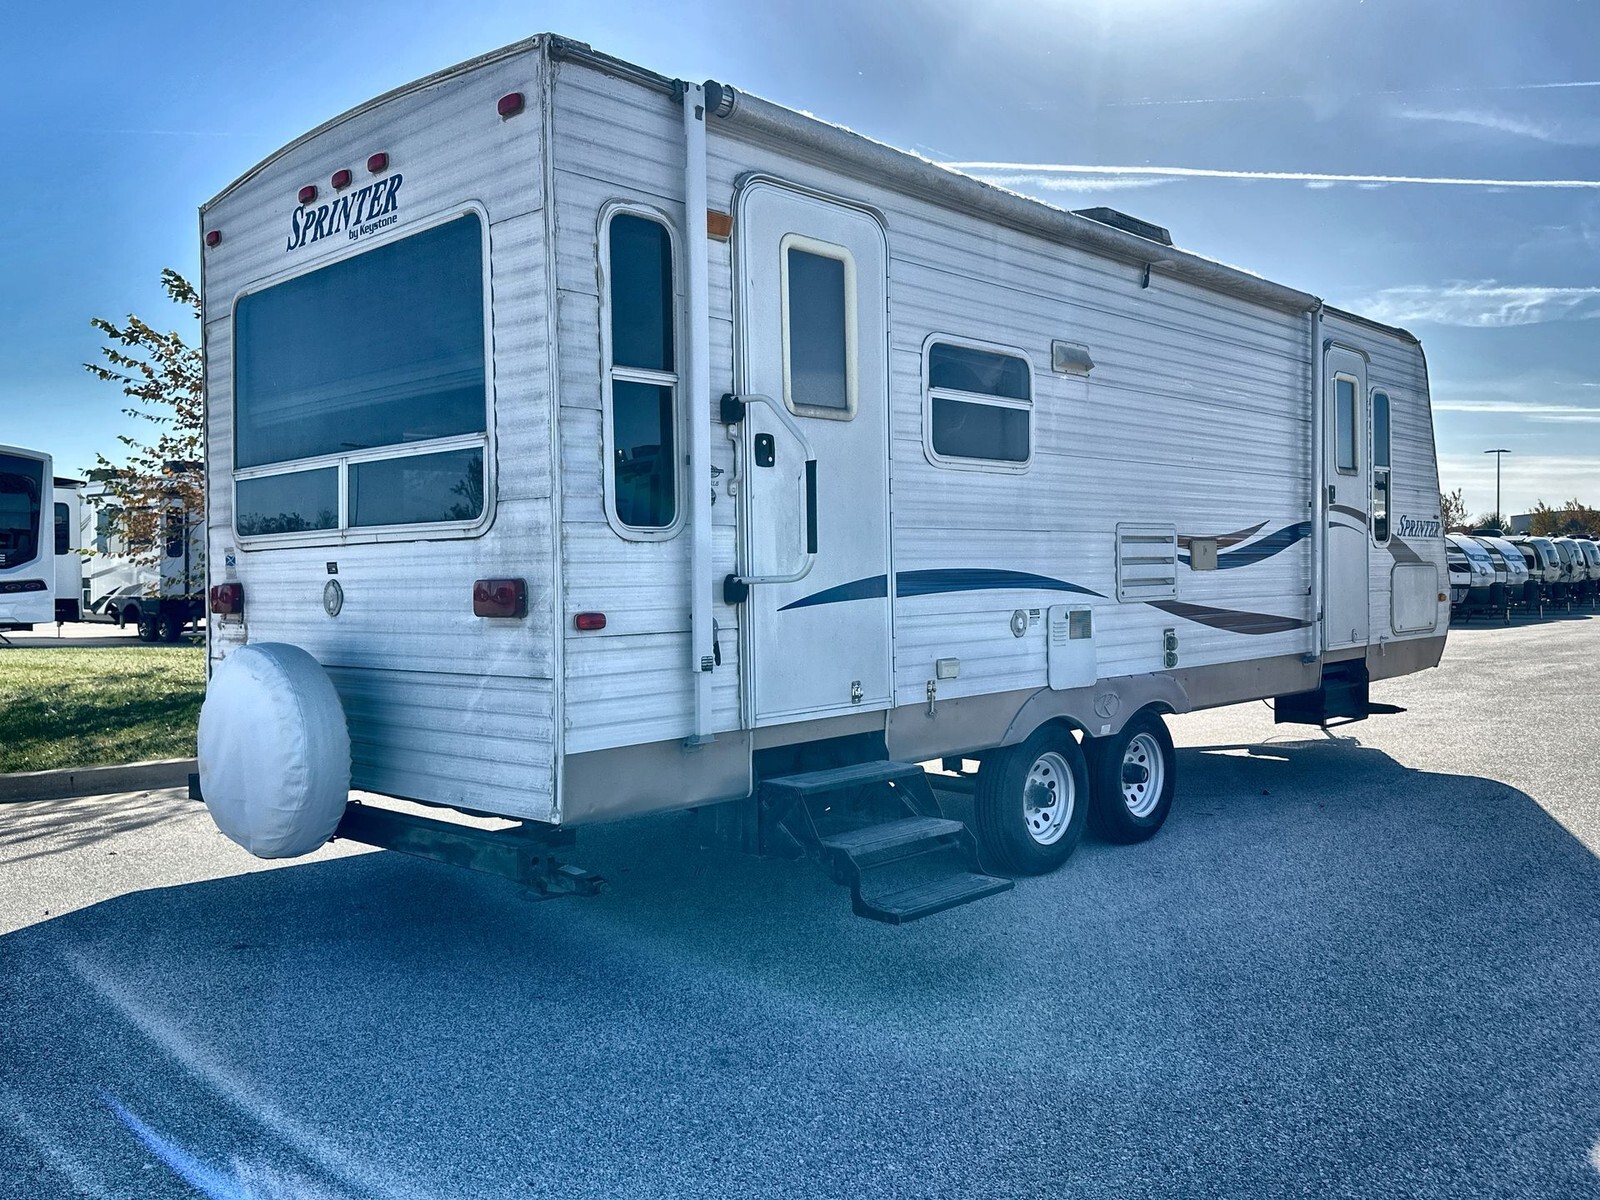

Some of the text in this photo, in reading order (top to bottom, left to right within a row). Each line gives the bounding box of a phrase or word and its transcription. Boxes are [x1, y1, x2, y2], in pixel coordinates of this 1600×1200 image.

[286, 173, 403, 252] SPRINTER
[349, 214, 398, 241] by Keystone
[1397, 514, 1440, 538] SPRINTER
